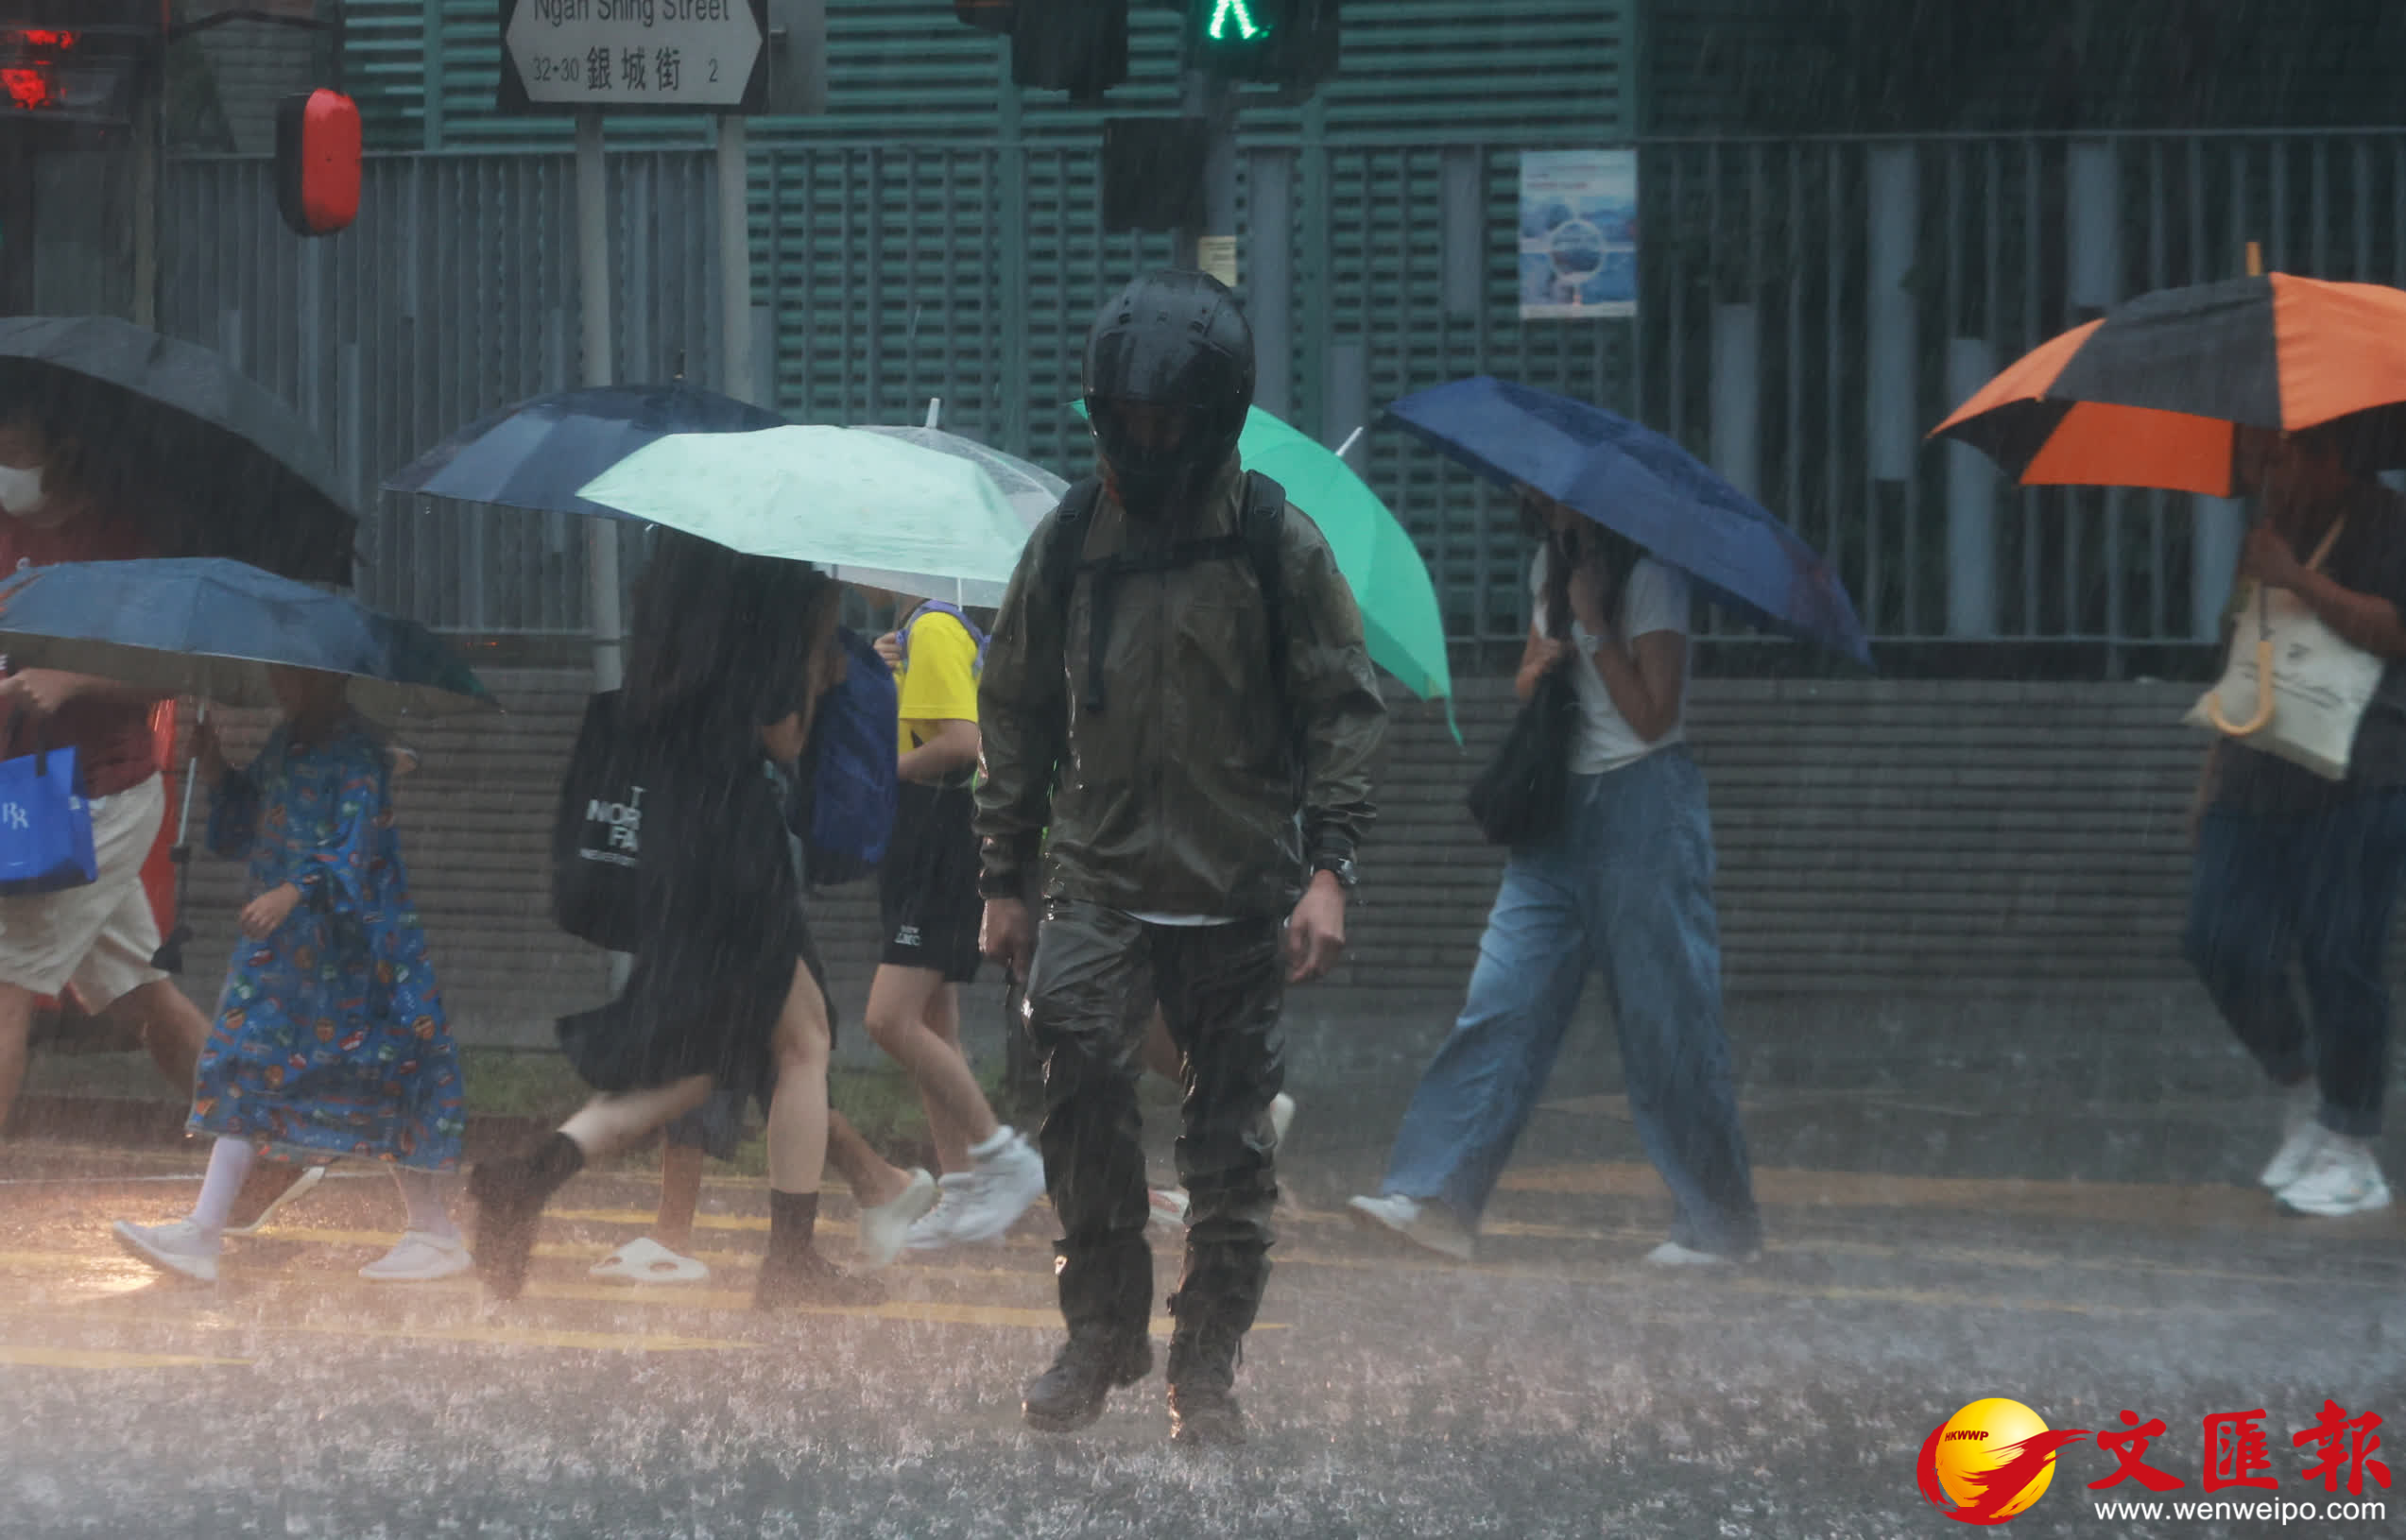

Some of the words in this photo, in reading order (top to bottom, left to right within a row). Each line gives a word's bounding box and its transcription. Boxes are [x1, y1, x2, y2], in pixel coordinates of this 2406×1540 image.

[533, 0, 589, 26] Ngan
[597, 0, 654, 27] Shing
[662, 0, 730, 21] Street
[586, 45, 681, 92] 銀城街
[709, 59, 718, 82] 2
